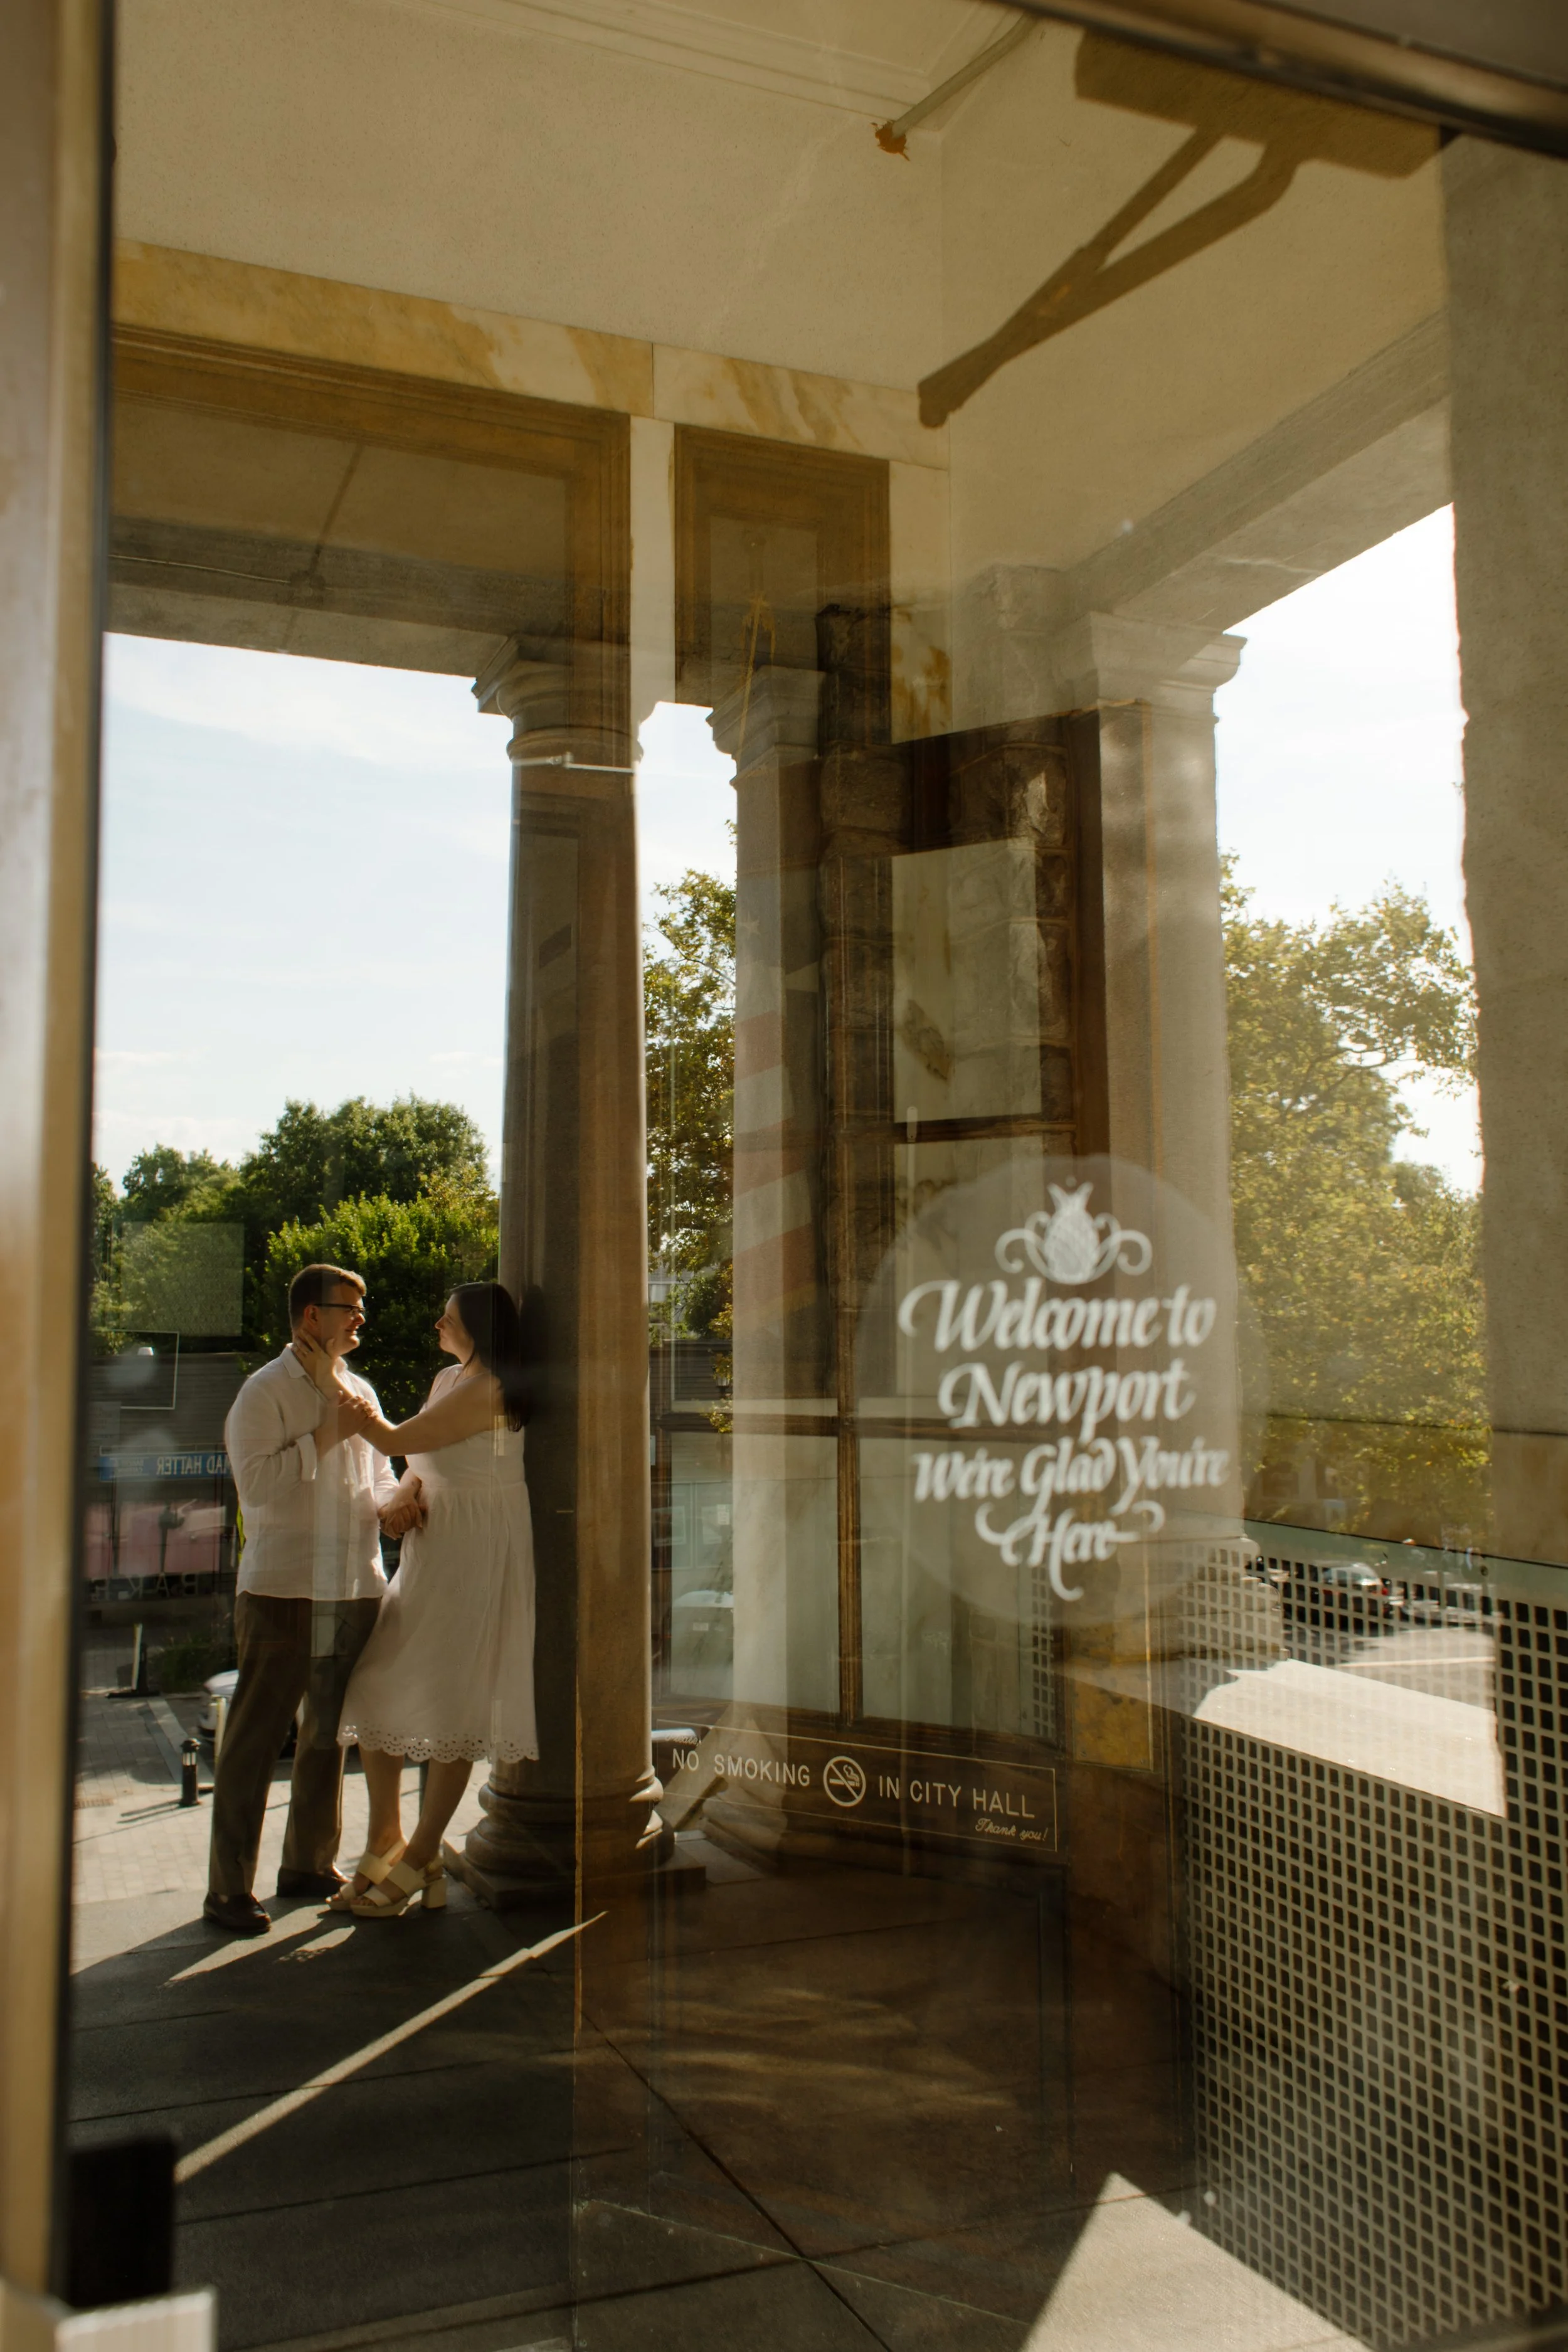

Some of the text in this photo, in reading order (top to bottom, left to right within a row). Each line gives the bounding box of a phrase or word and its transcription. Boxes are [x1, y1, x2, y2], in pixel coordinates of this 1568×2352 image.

[898, 1276, 1216, 1352] Welcome to
[938, 1357, 1196, 1443] Newport
[1020, 1436, 1116, 1518] Glad
[975, 1501, 1165, 1602] Here
[672, 1748, 1036, 1819] NO SMOKING IN CITY HALL
[975, 1817, 1049, 1842] Thank you!
